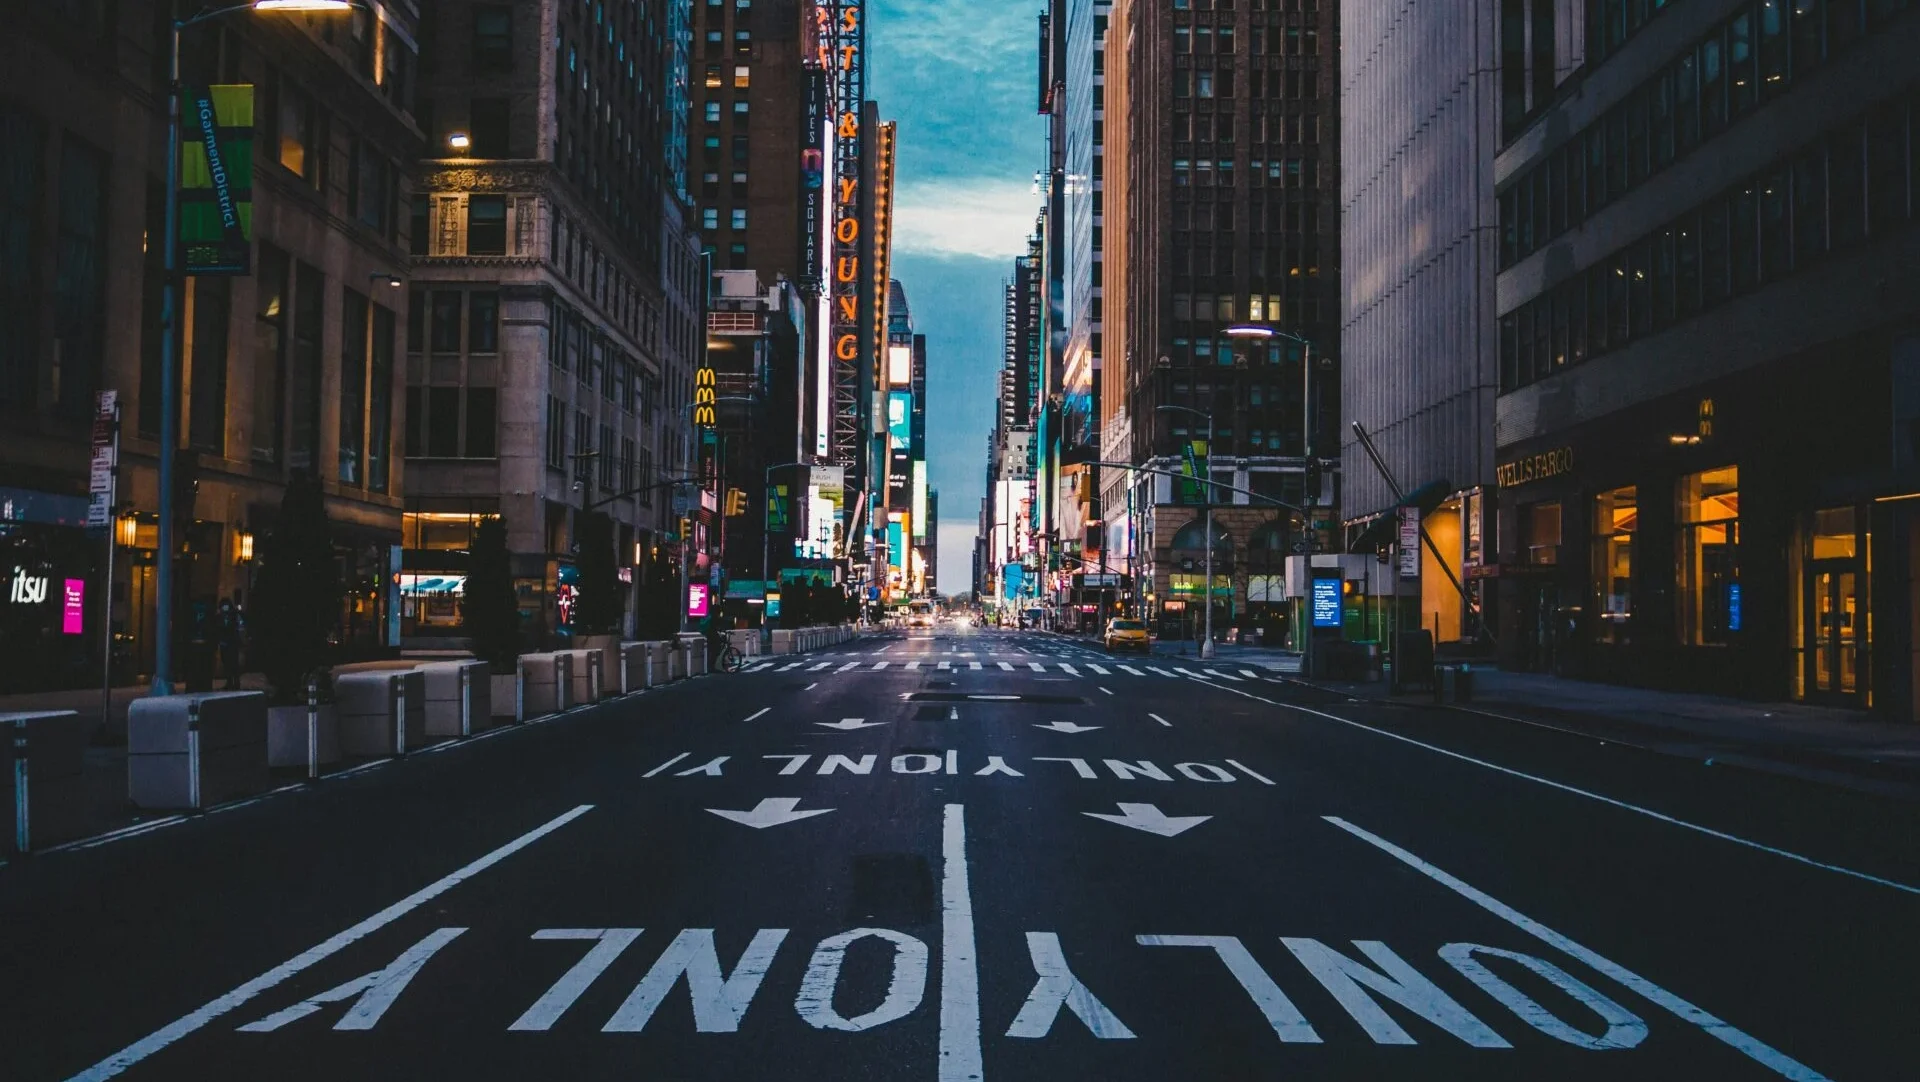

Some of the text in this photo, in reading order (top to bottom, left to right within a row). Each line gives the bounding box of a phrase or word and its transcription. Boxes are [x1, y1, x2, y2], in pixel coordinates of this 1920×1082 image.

[808, 75, 817, 144] TIMES
[196, 98, 237, 229] #GarmentDistrict
[805, 193, 816, 276] SQUARE
[836, 177, 859, 361] YOUNG
[1496, 446, 1574, 488] WELLS FARGO
[10, 564, 48, 603] itsu
[674, 753, 944, 777] ONLY
[975, 755, 1240, 783] ONLY
[236, 926, 930, 1032] ONLY
[1004, 930, 1650, 1050] ONLY
